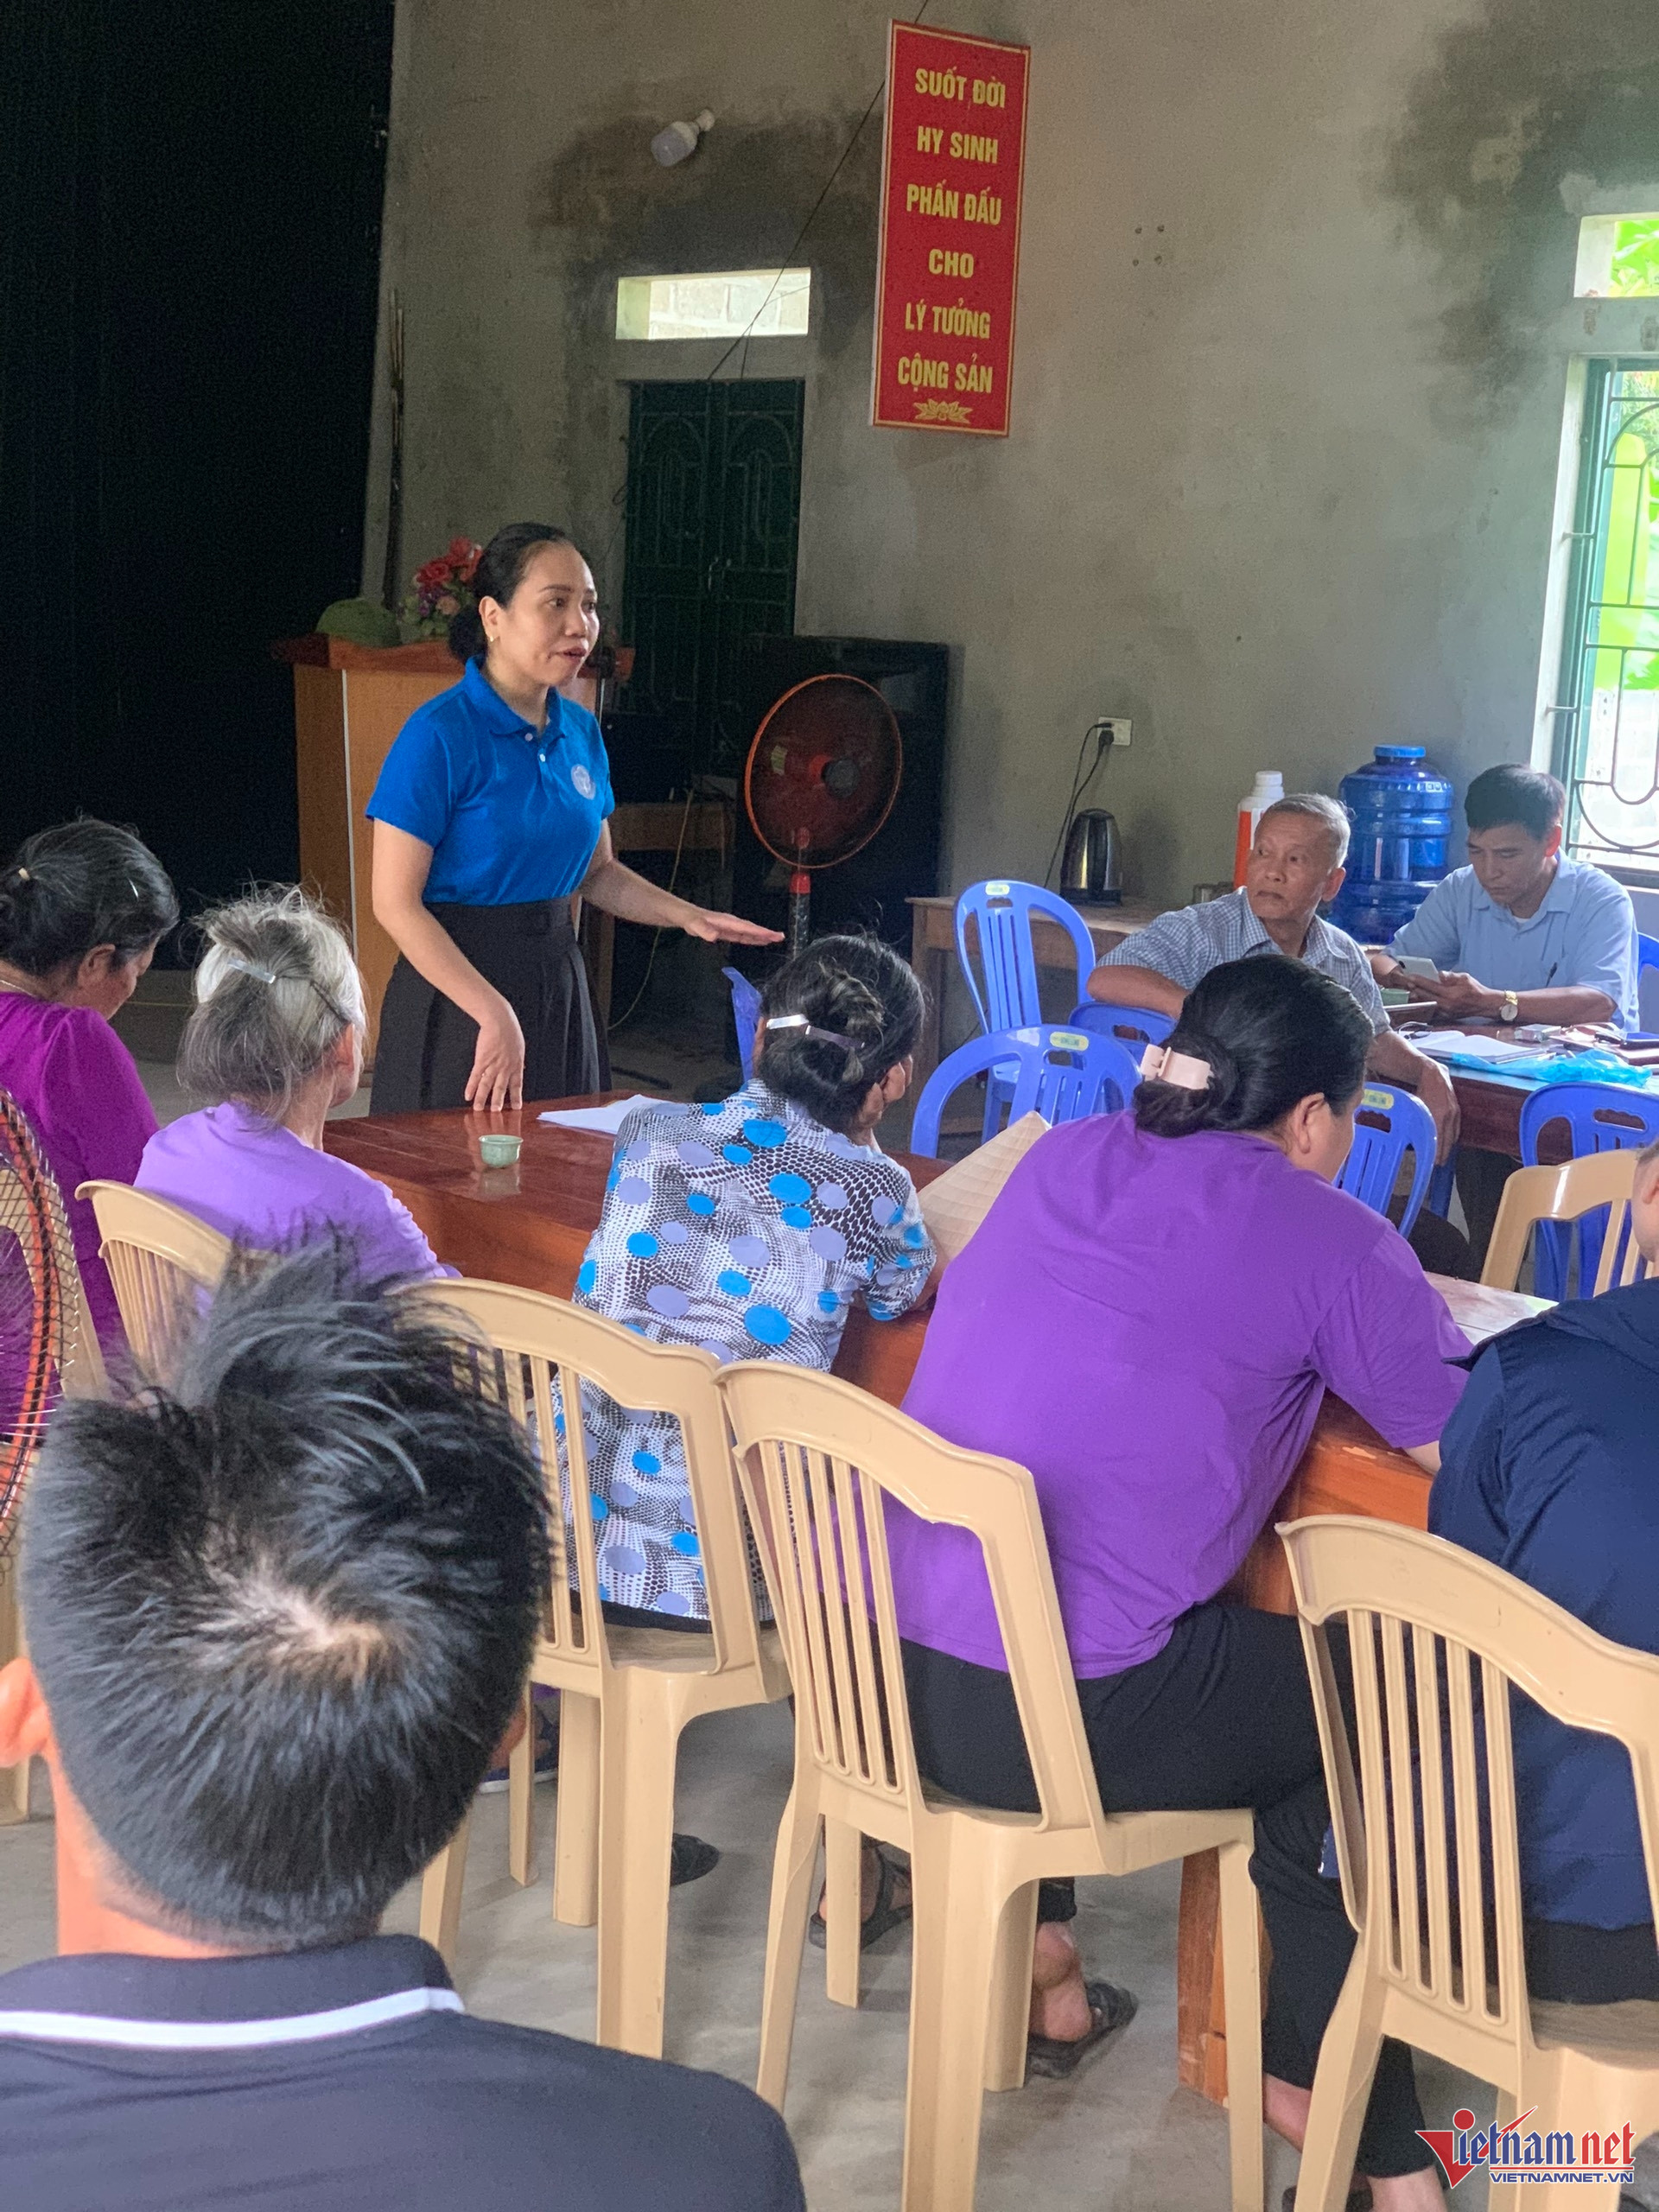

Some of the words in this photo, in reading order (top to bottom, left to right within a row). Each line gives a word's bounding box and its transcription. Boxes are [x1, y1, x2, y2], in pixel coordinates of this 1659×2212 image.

[914, 66, 968, 101] SUỐT
[917, 125, 944, 155] HY
[950, 131, 999, 164] SINH
[906, 179, 959, 219] PHẤN
[963, 186, 1002, 226] ĐẤU
[928, 248, 975, 278] CHO
[905, 298, 927, 332] LÝ
[931, 297, 991, 340] TƯỞNG
[897, 353, 950, 392] CỘNG
[954, 353, 993, 394] SẢN
